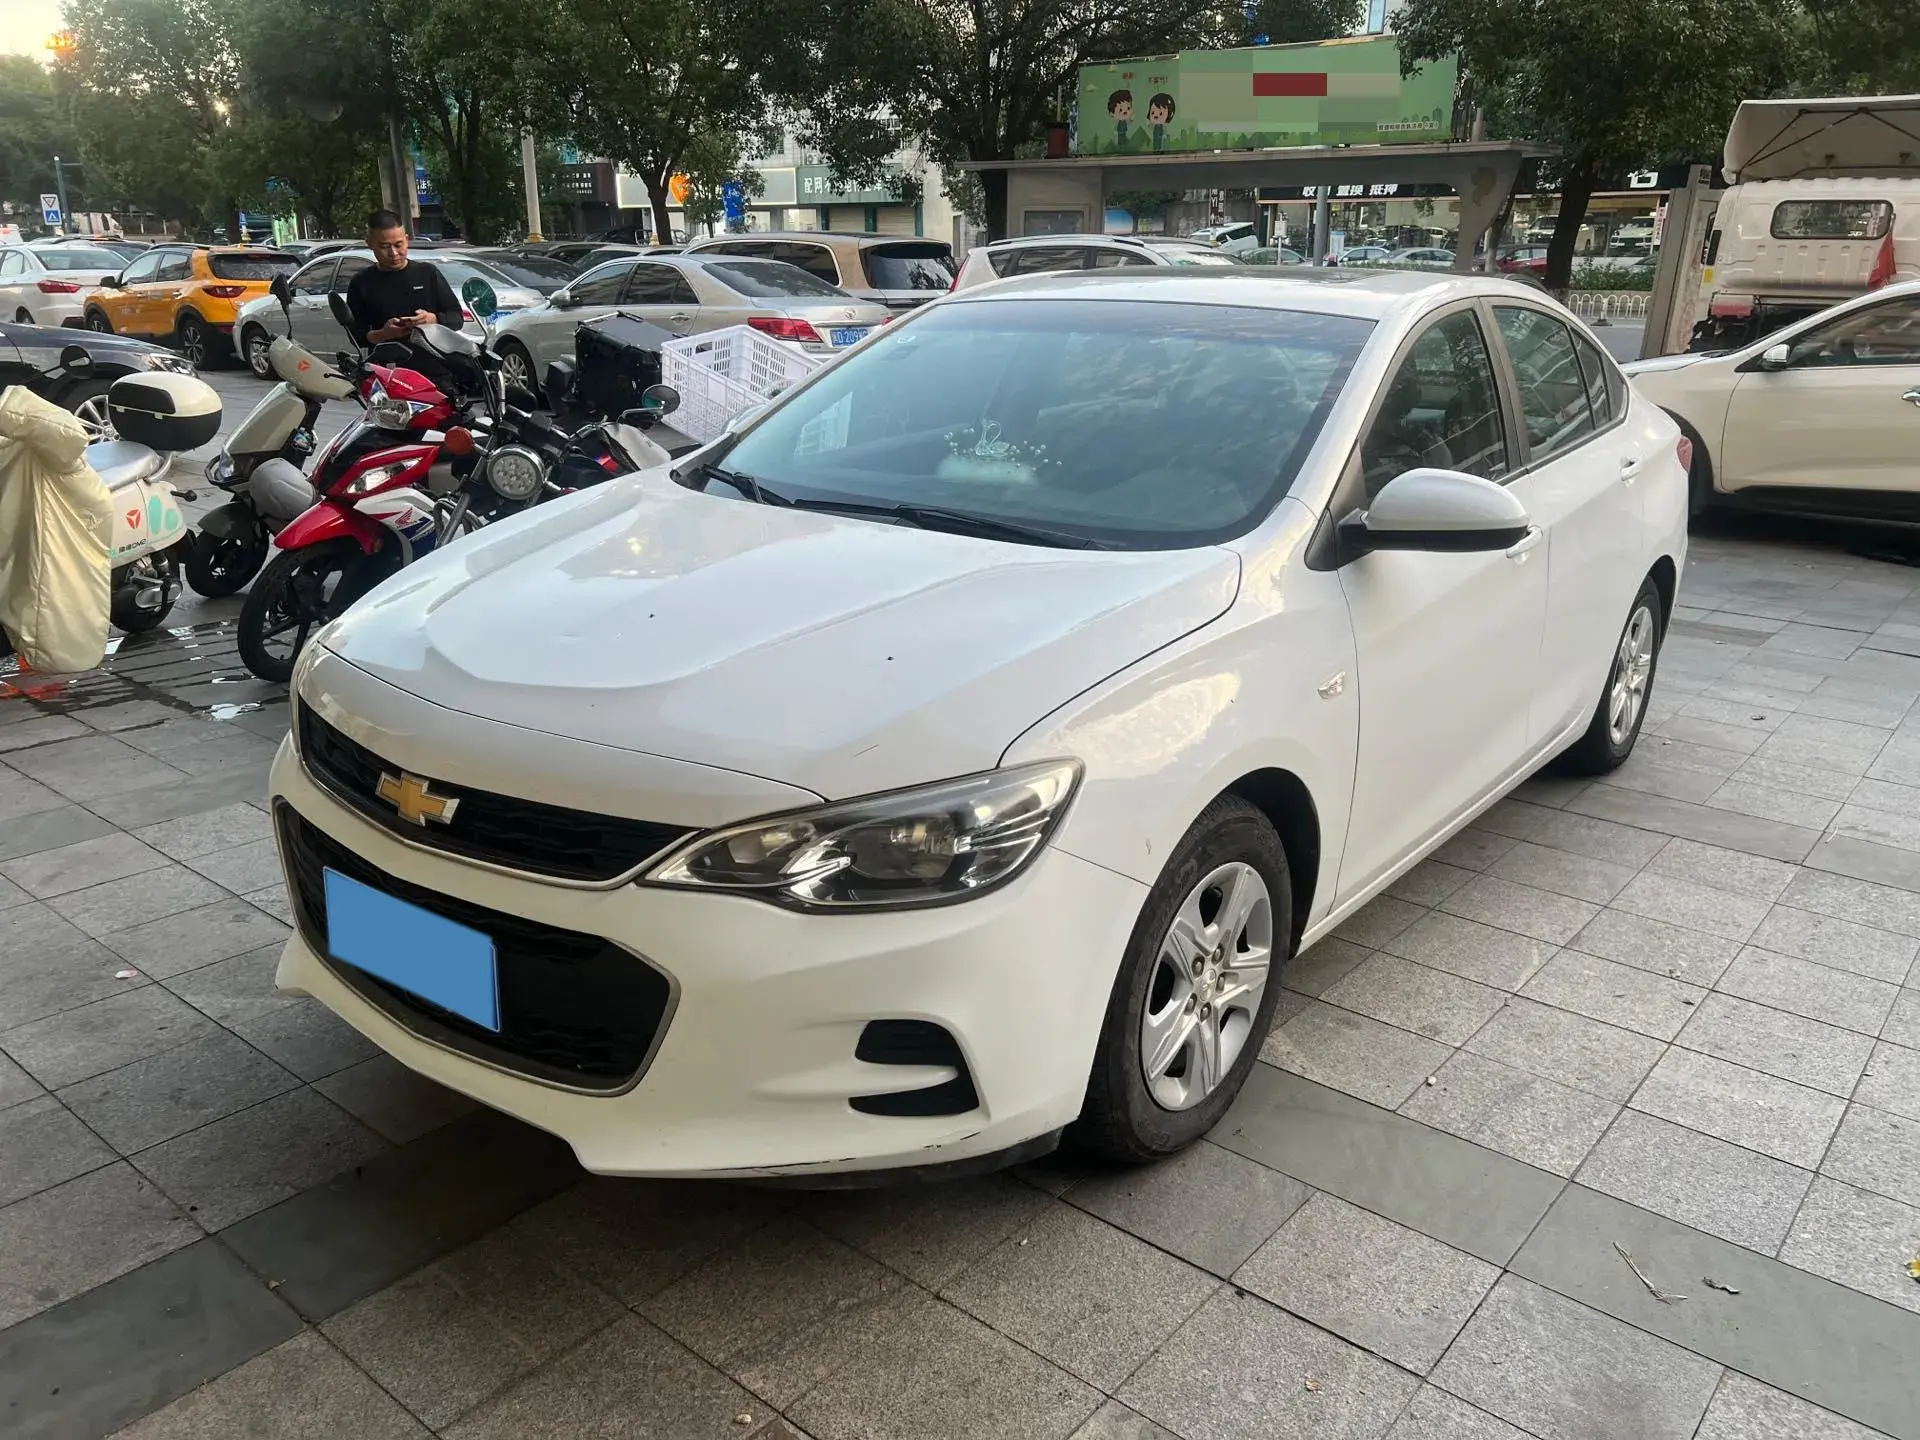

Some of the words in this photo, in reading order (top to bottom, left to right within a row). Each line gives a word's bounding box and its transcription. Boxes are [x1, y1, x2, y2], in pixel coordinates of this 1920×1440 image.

[1302, 185, 1332, 197] 收
[1336, 184, 1364, 196] 置换
[1369, 183, 1399, 196] 抵押
